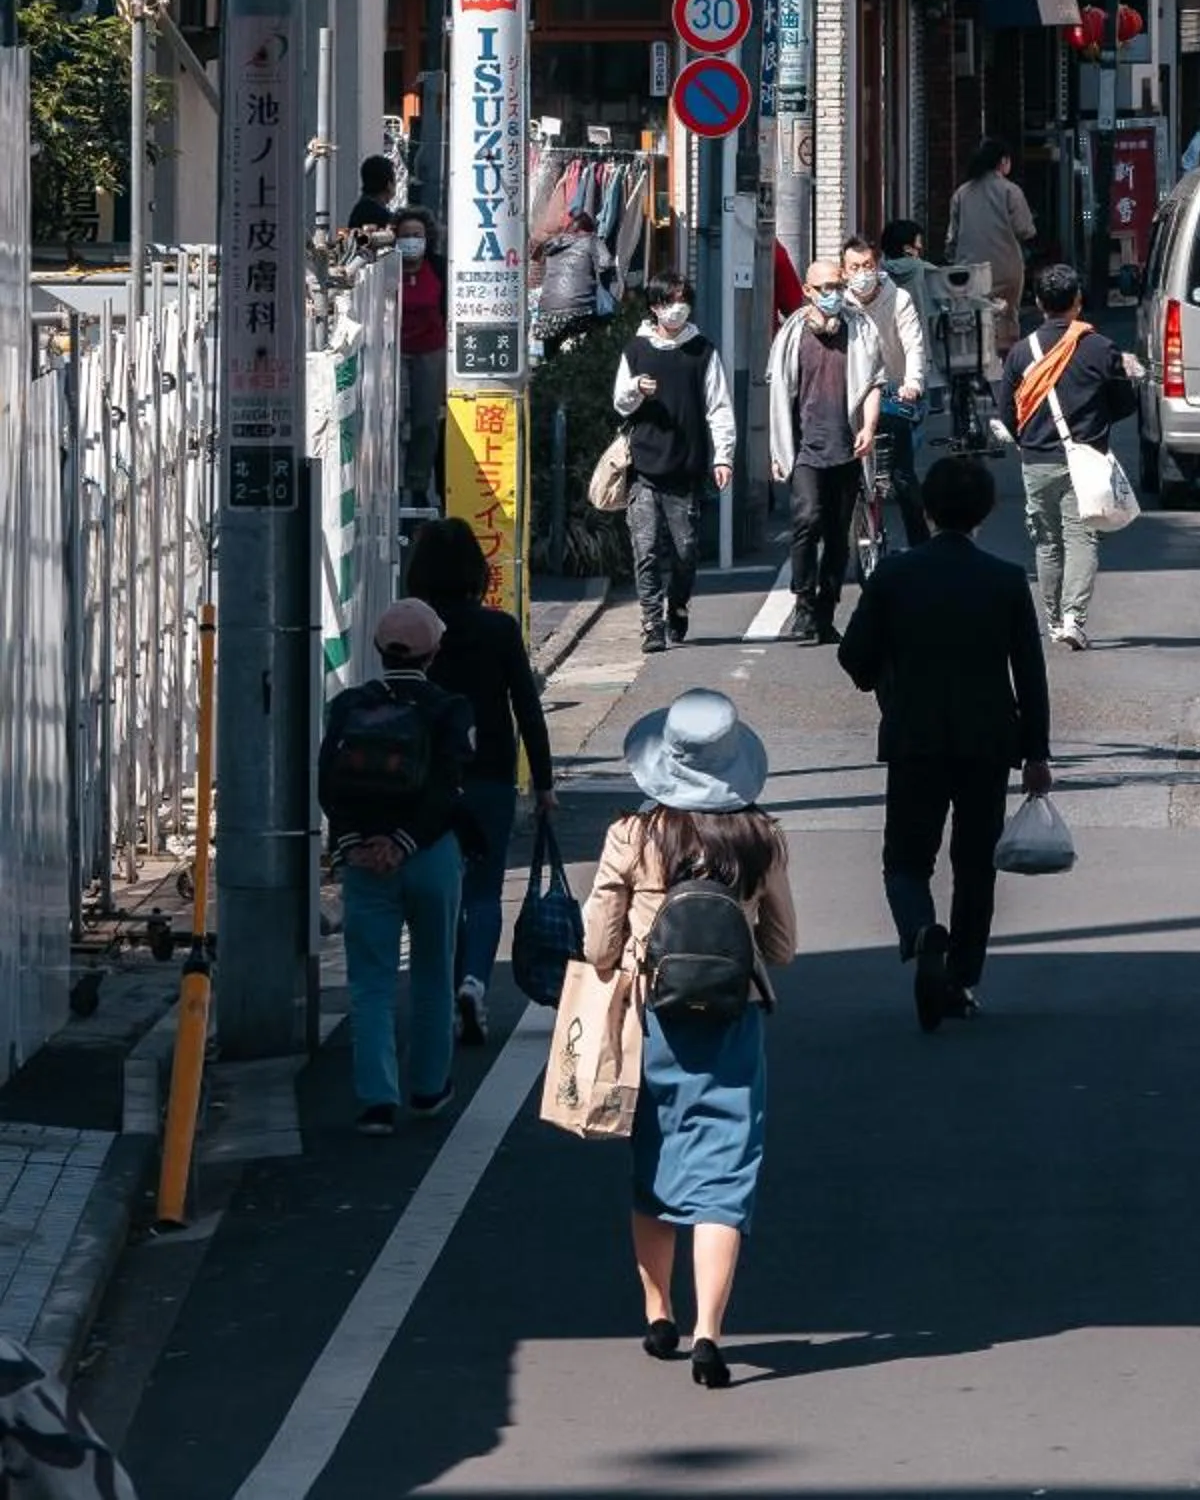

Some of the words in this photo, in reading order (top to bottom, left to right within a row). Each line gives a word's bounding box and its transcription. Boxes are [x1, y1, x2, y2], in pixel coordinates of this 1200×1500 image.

[471, 27, 506, 262] ISUZUYA
[246, 93, 281, 336] 池ノ上皮膚科
[463, 335, 509, 349] 北沢
[464, 353, 509, 368] 2-10
[235, 483, 288, 500] 2-10
